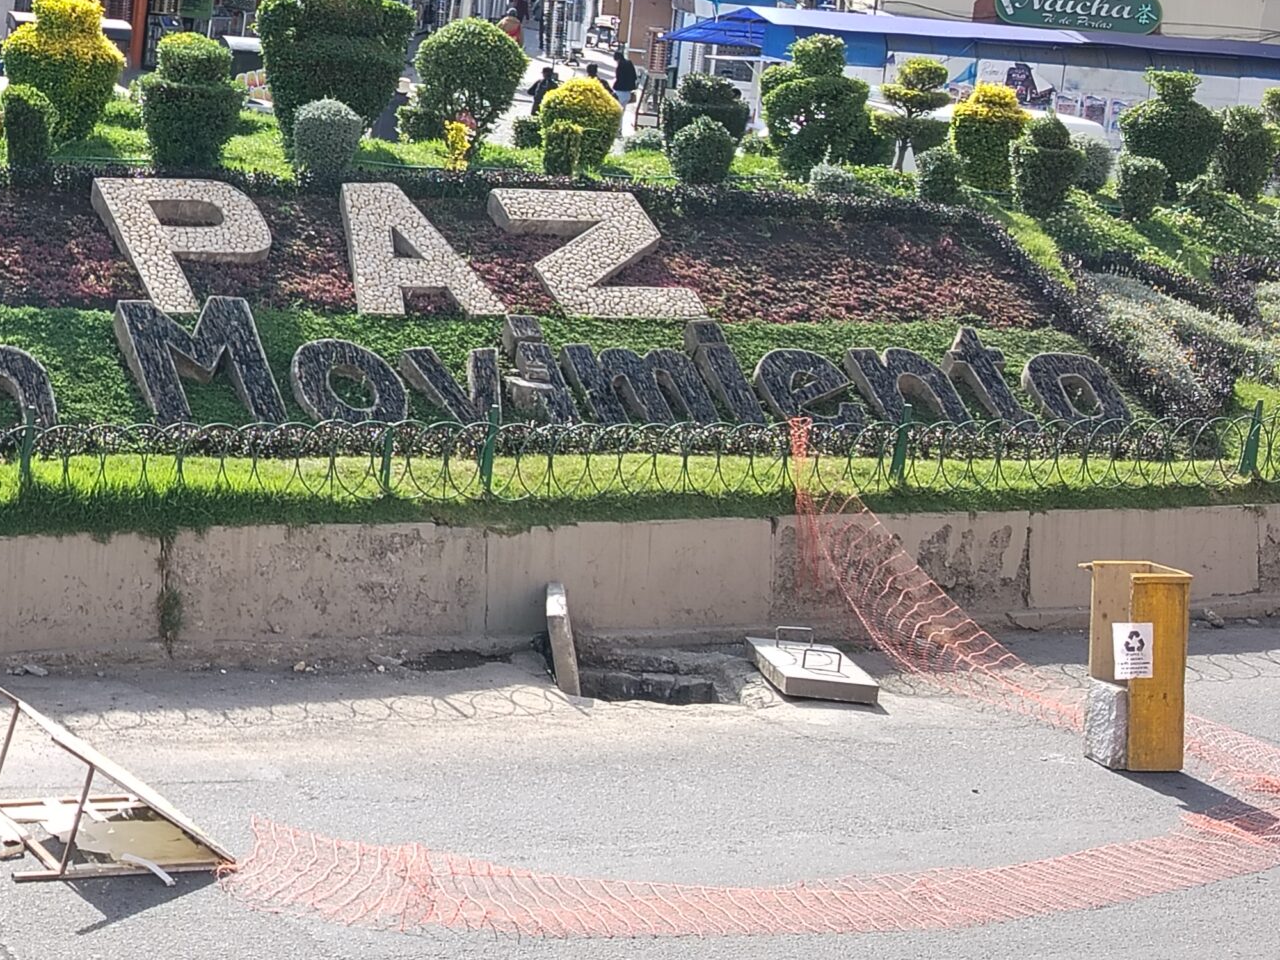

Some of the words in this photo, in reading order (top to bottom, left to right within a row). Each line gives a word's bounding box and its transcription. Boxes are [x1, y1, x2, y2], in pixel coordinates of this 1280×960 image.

[1059, 16, 1072, 25] de
[1076, 15, 1113, 29] Perlas
[90, 177, 708, 319] PAZ
[112, 295, 1134, 435] Movimiento
